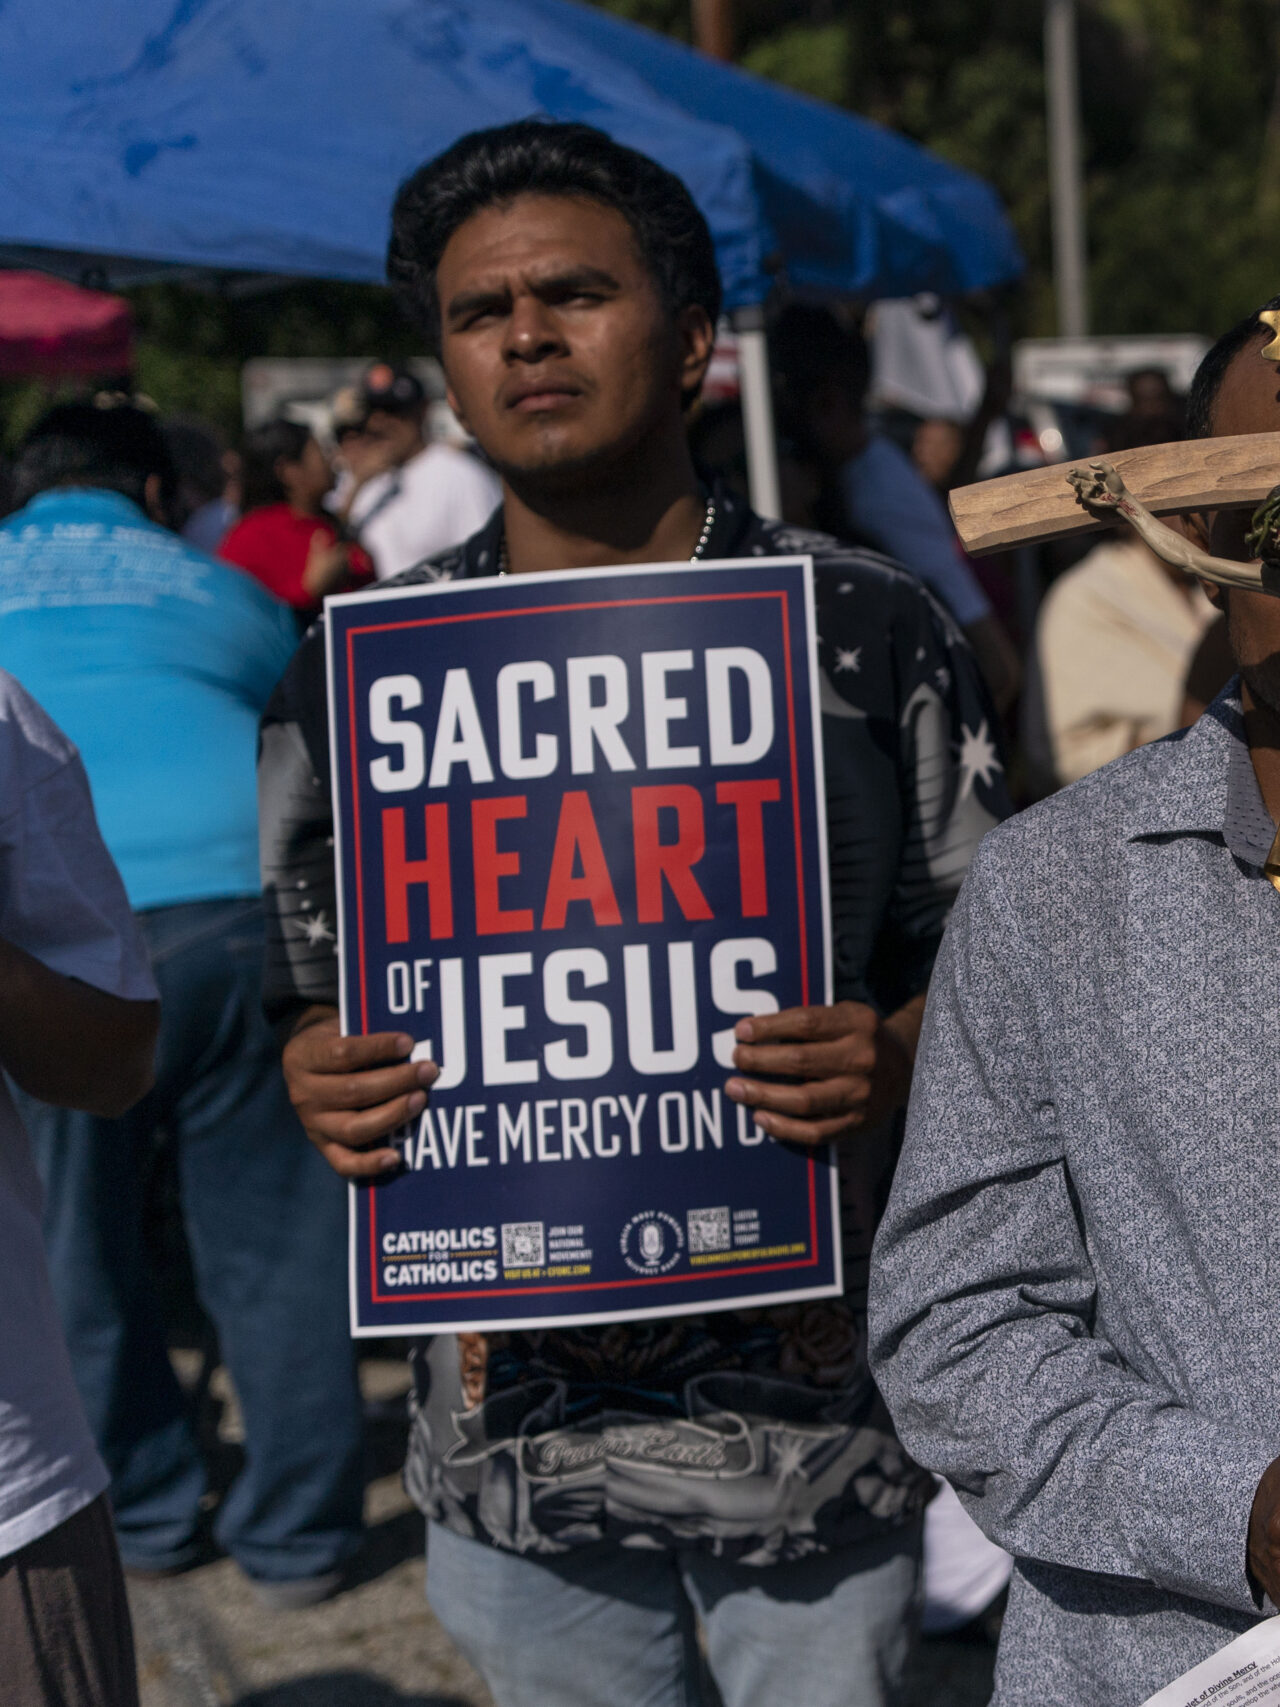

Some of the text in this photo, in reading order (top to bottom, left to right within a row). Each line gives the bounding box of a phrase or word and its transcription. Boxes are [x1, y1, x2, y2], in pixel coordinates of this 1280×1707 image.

[368, 646, 776, 793] SACRED
[381, 778, 781, 945] HEART
[386, 937, 780, 1091] OF JESUS
[498, 1093, 648, 1165] MERCY
[657, 1088, 724, 1156] ON
[736, 1103, 777, 1146] U
[382, 1226, 497, 1255] CATHOLICS
[428, 1250, 449, 1262] FOR
[383, 1259, 498, 1287] CATHOLICS
[1199, 1690, 1208, 1700] of
[1207, 1675, 1233, 1695] Divine
[1232, 1661, 1258, 1680] Mercy
[1260, 1663, 1271, 1672] the
[1245, 1686, 1258, 1696] and
[1257, 1679, 1269, 1689] the
